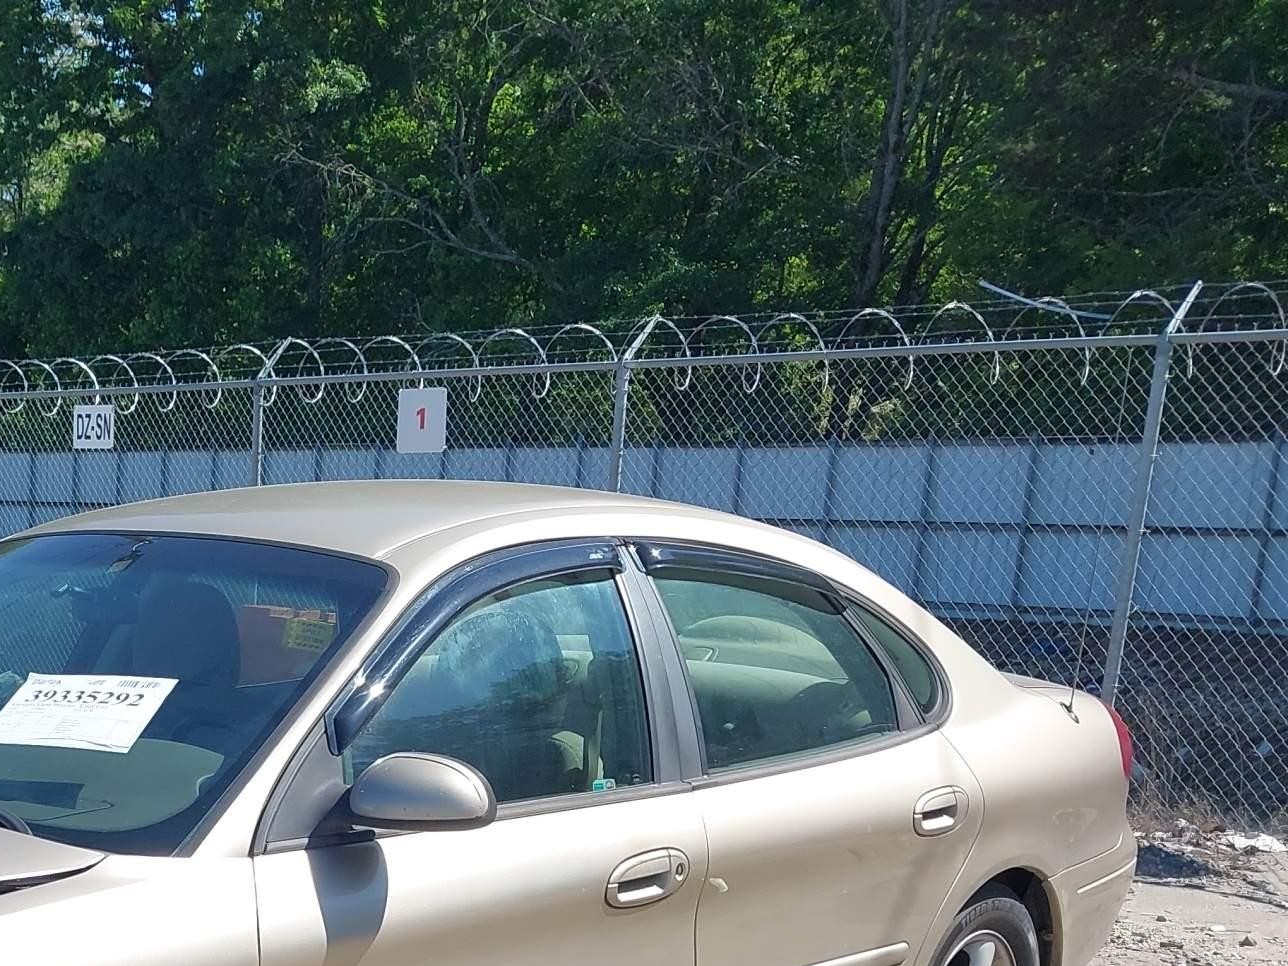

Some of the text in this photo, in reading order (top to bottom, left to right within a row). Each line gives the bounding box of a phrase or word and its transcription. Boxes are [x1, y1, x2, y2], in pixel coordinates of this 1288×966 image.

[76, 413, 111, 440] DZ-SN
[416, 407, 425, 430] 1
[24, 689, 146, 706] 39335292
